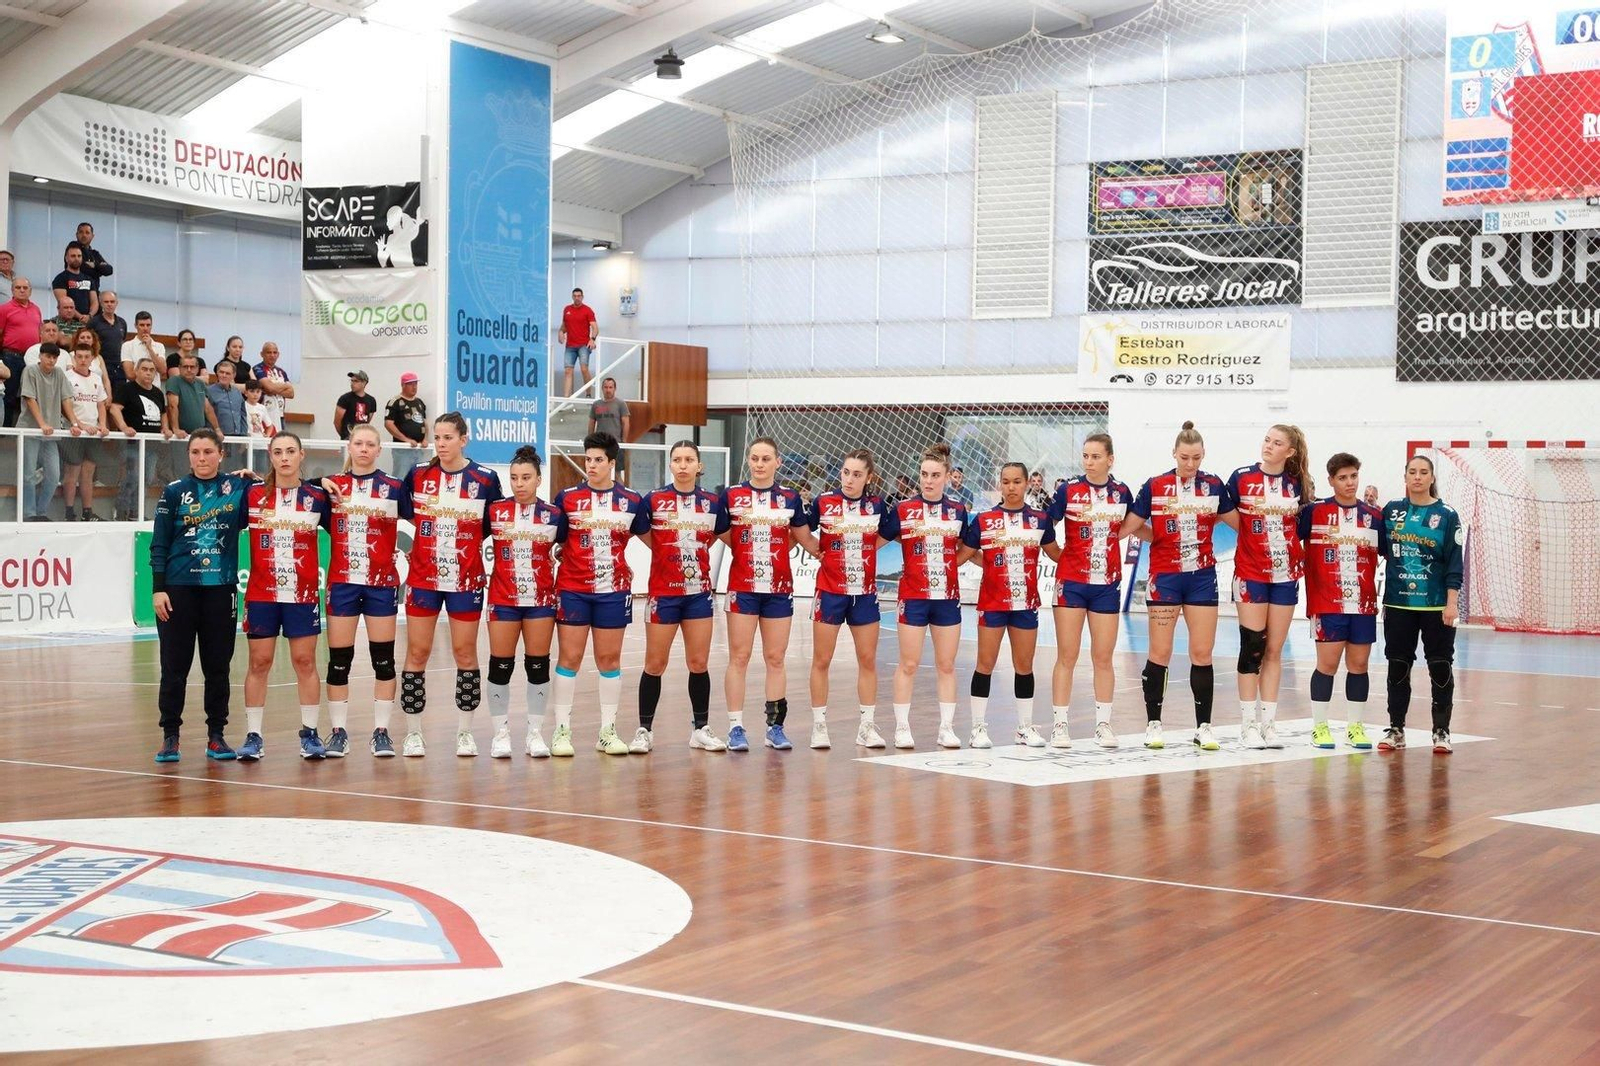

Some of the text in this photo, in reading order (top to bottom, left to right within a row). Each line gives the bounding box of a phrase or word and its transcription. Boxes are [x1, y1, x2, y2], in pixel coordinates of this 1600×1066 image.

[1468, 36, 1492, 69] 0
[175, 139, 302, 182] DEPUTACIÓN
[175, 166, 302, 207] PONTEVEDRA
[307, 195, 375, 221] SCAPE
[1502, 211, 1530, 219] XUNTA
[1502, 220, 1513, 228] DE
[1514, 218, 1547, 227] GALICIA
[306, 223, 375, 239] INFORMÁTICA
[1107, 279, 1292, 305] Talleres Jocar
[457, 309, 539, 343] Concello da
[1141, 319, 1284, 330] DISTRIBUIDOR LABORAL
[372, 325, 428, 338] OPOSICIONES
[1119, 336, 1185, 349] Esteban
[457, 340, 539, 388] Guarda
[1118, 353, 1172, 366] Castro
[1165, 374, 1254, 385] 627 915 153
[456, 391, 538, 416] Pavillón municipal
[476, 417, 538, 444] SANGRIÑA
[422, 480, 437, 494] 13
[1164, 484, 1176, 496] 71
[1247, 483, 1264, 495] 77
[181, 491, 194, 506] 16
[734, 496, 751, 508] 23
[1072, 492, 1091, 504] 44
[576, 499, 590, 511] 17
[656, 499, 675, 512] 22
[824, 504, 843, 516] 24
[495, 510, 510, 522] 14
[906, 508, 923, 520] 27
[1327, 513, 1337, 525] 11
[1390, 509, 1407, 522] 32
[985, 518, 1004, 530] 38
